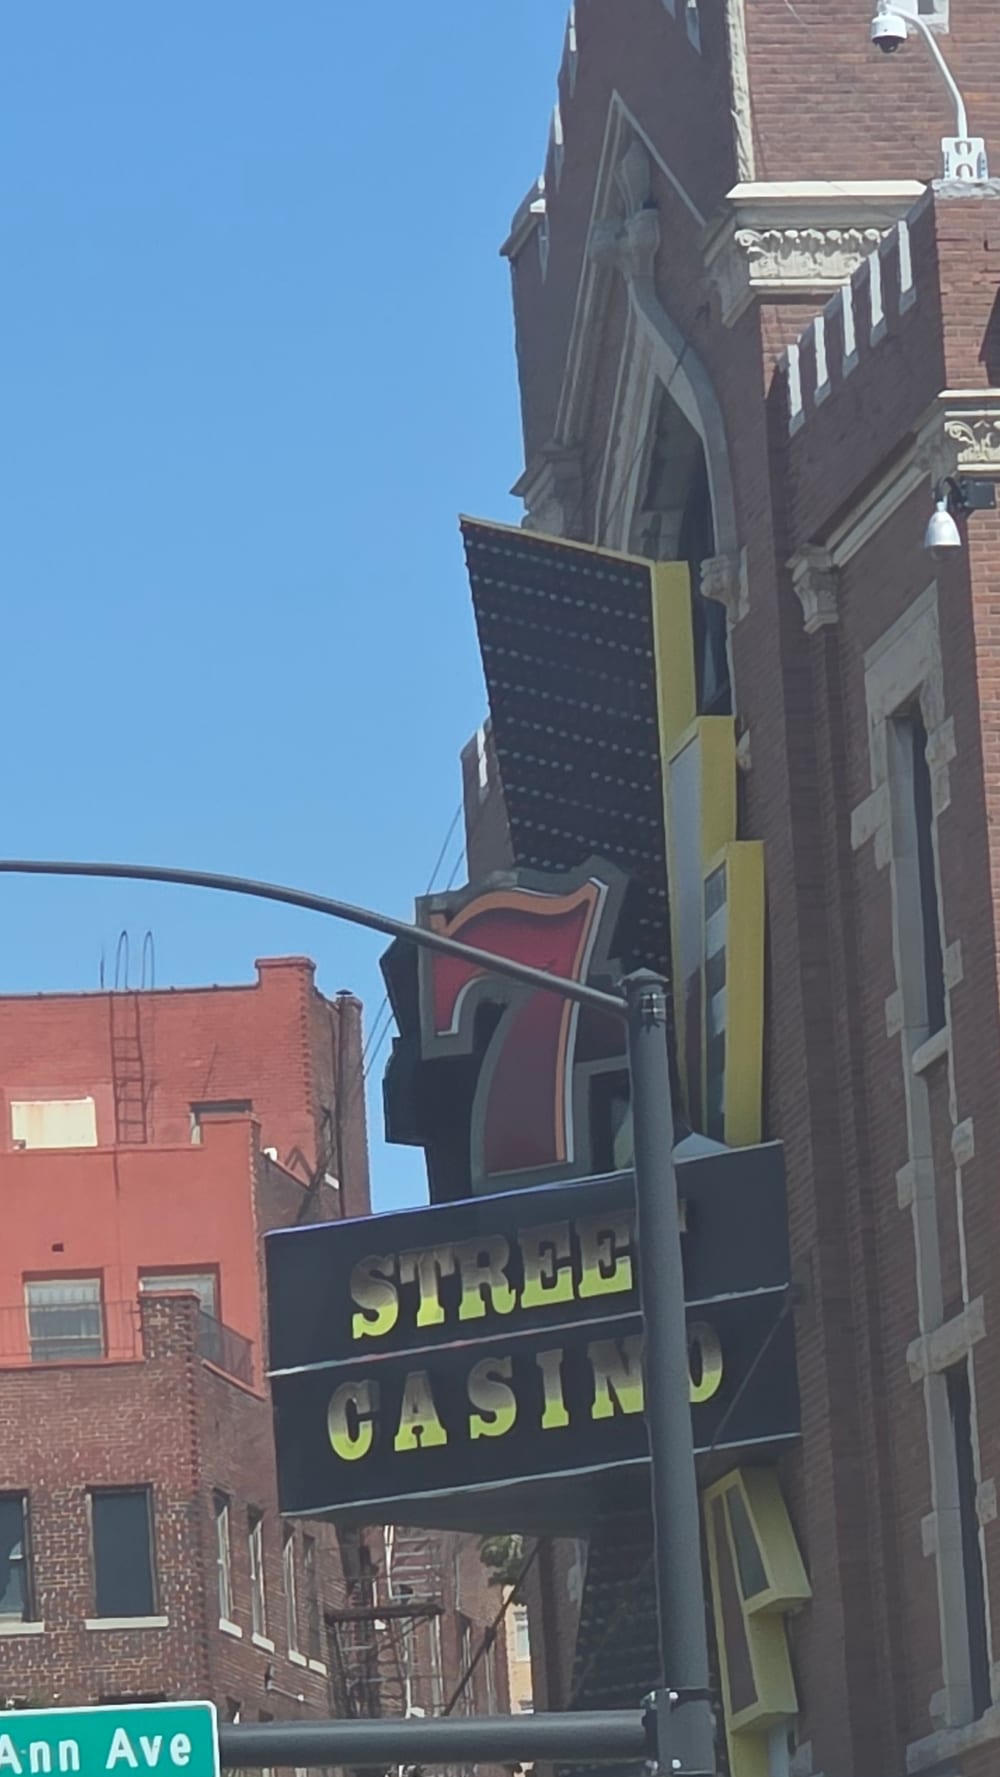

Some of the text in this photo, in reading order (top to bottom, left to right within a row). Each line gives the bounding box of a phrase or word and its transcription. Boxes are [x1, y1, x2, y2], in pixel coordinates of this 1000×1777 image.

[428, 876, 609, 1177] 7
[349, 1198, 688, 1340] STREE
[326, 1320, 724, 1461] CASINO
[0, 1728, 192, 1775] Ann Ave
